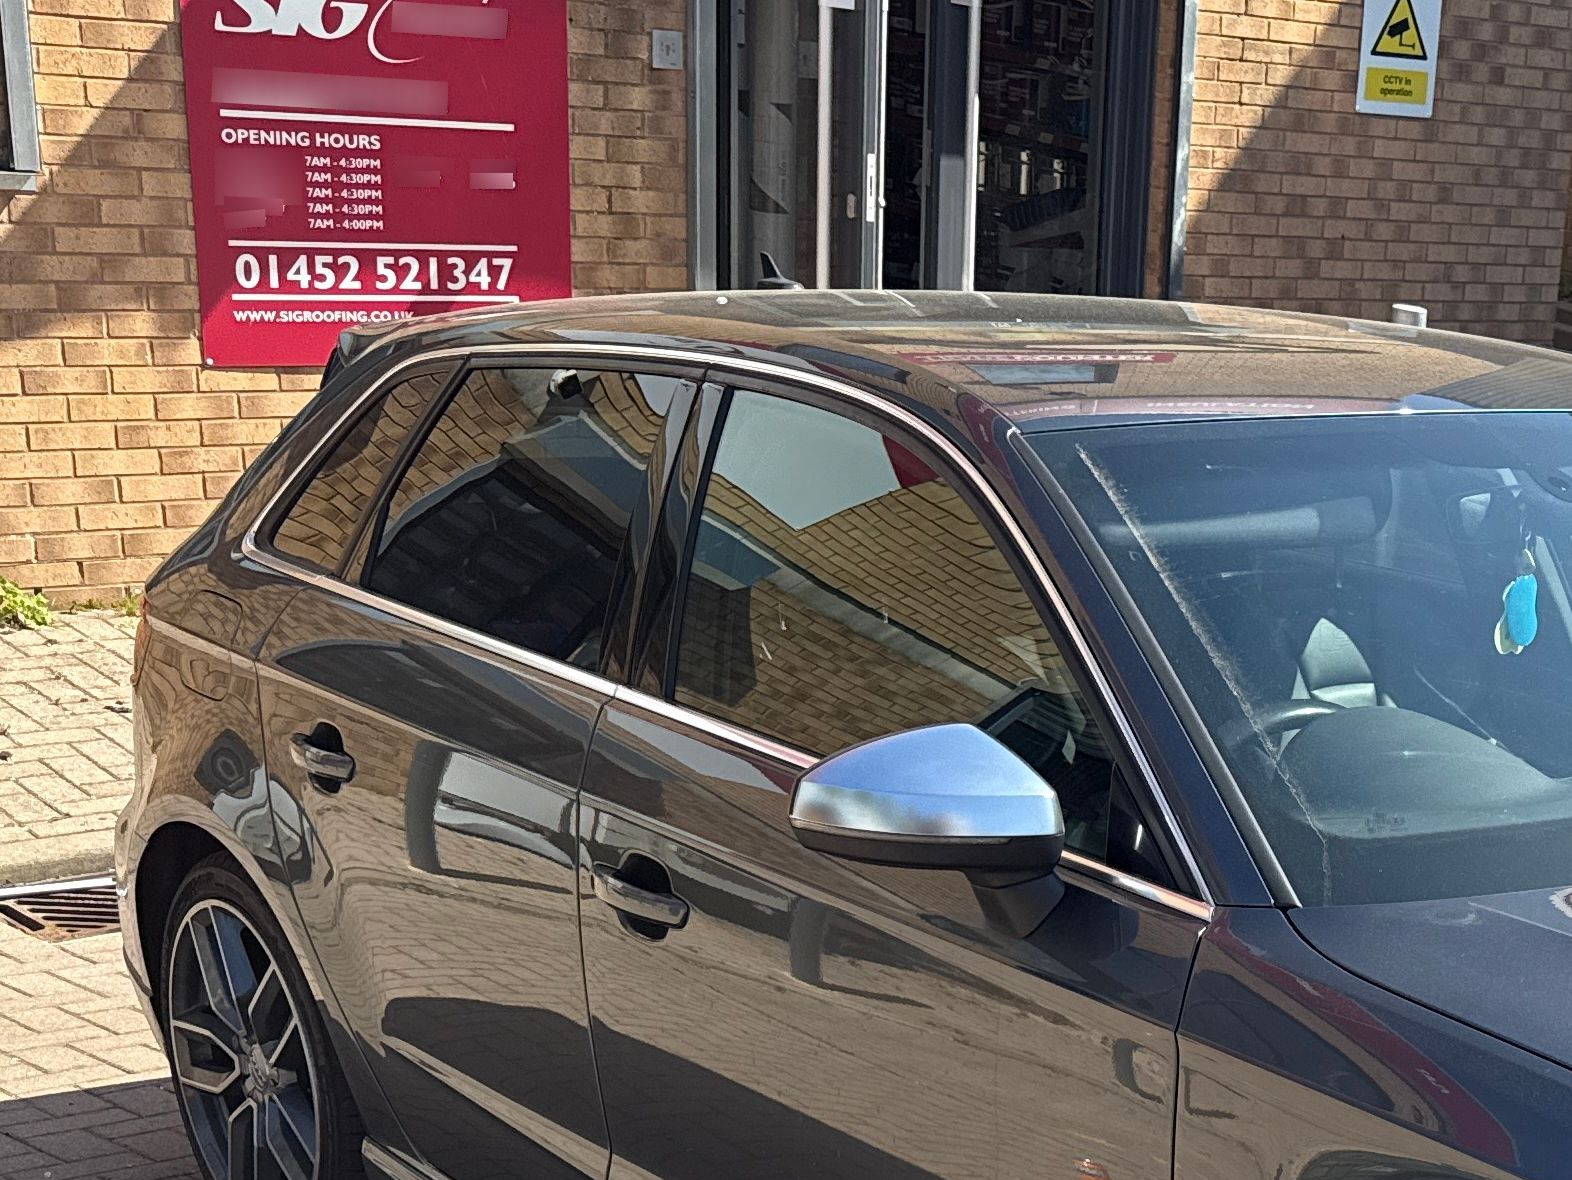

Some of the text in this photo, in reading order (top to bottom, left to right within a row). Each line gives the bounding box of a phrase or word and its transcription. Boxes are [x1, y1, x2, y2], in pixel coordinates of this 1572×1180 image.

[1383, 75, 1404, 85] CCTV
[1380, 88, 1413, 97] operation
[221, 128, 381, 150] OPENING HOURS
[304, 155, 331, 168] 7AM
[339, 157, 381, 169] 4:30PM
[305, 171, 332, 184] 7AM
[340, 173, 382, 185] 4:30PM
[306, 187, 333, 199] 7AM
[340, 189, 383, 200] 4:30PM
[307, 202, 334, 214] 7AM
[341, 204, 383, 215] 4:30PM
[308, 218, 335, 229] 7AM
[342, 219, 384, 231] 4:00PM
[235, 253, 514, 291] 01452 521347
[233, 310, 414, 324] WWW.SIGROOFING.COUK
